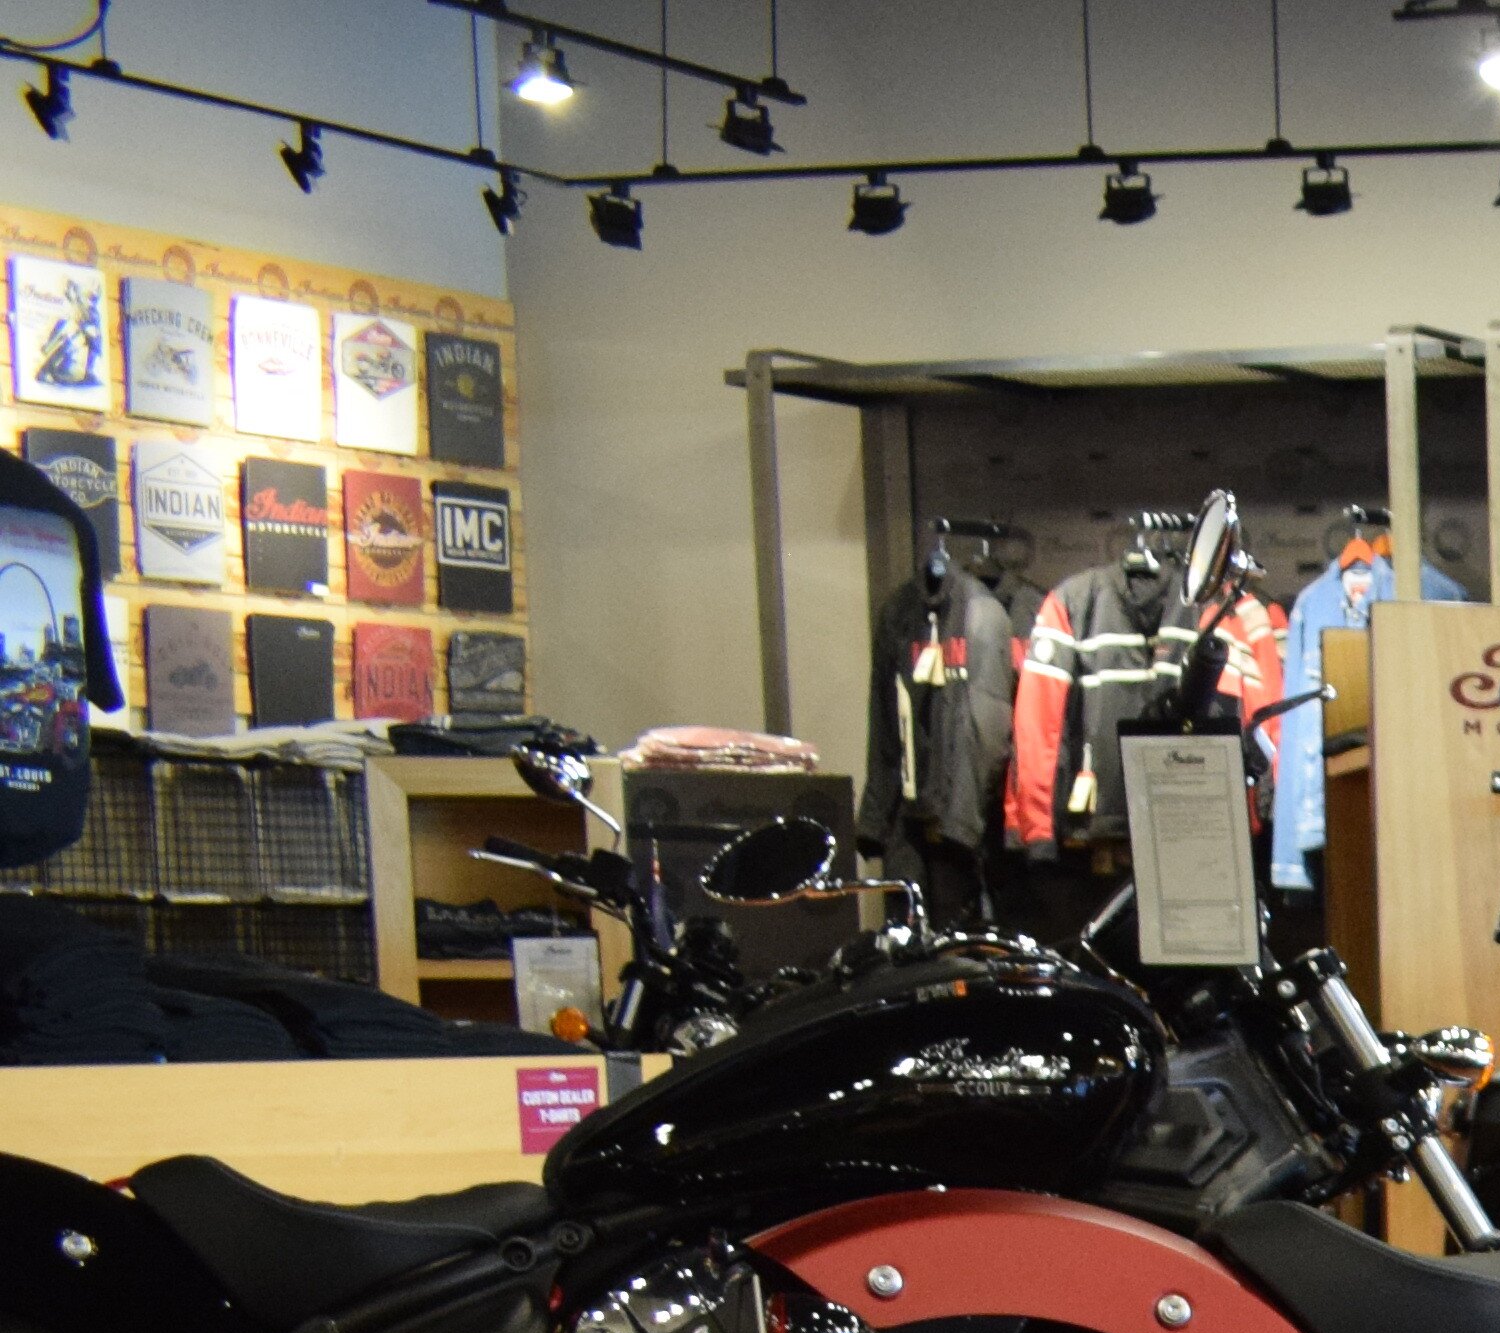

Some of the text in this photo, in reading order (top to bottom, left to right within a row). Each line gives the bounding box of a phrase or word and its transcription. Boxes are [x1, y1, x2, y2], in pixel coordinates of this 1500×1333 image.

[187, 317, 214, 344] CREW
[436, 343, 494, 375] INDIAN
[147, 486, 221, 520] INDIAN
[444, 506, 504, 551] IMC
